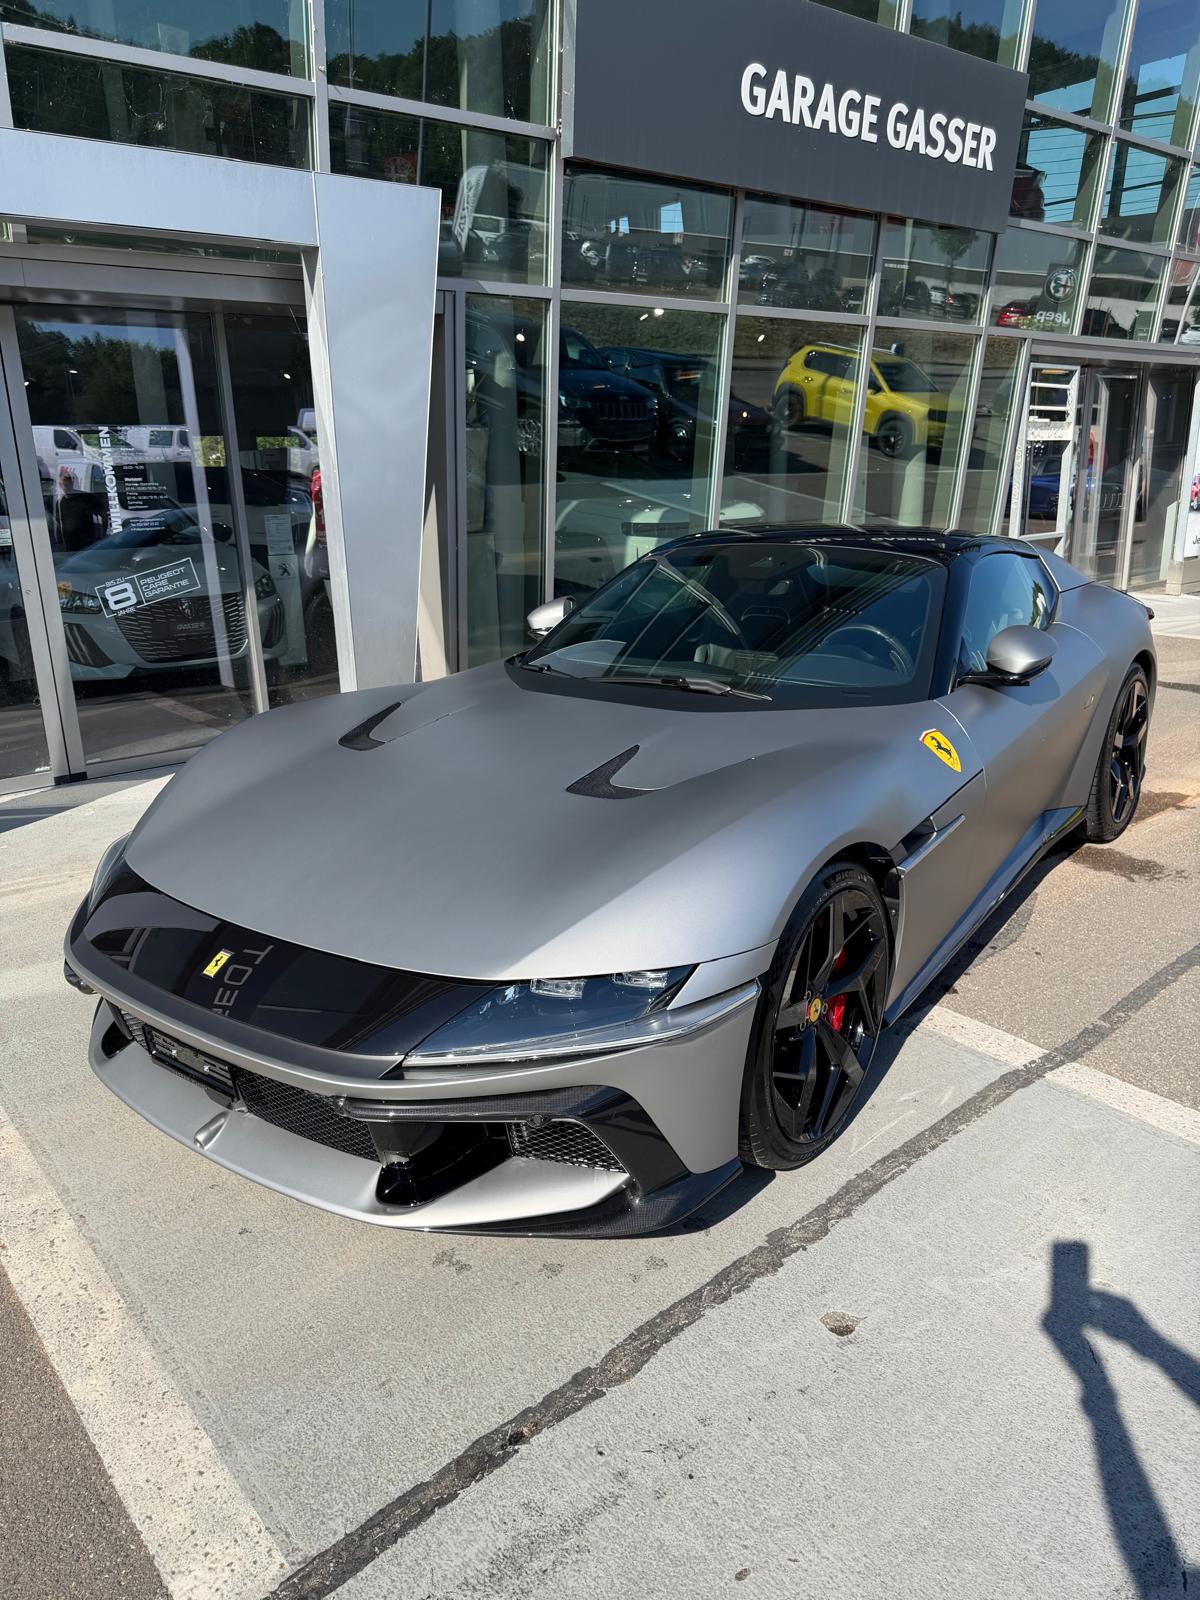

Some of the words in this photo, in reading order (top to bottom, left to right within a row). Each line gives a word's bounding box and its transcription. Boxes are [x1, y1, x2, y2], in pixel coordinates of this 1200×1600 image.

[740, 62, 882, 144] GARAGE
[886, 102, 997, 171] GASSER
[98, 426, 123, 534] WILLKOMMEN
[139, 566, 186, 586] PEUGEOT
[142, 579, 169, 592] CARE
[144, 578, 190, 598] GARANTIE
[104, 582, 137, 611] 8
